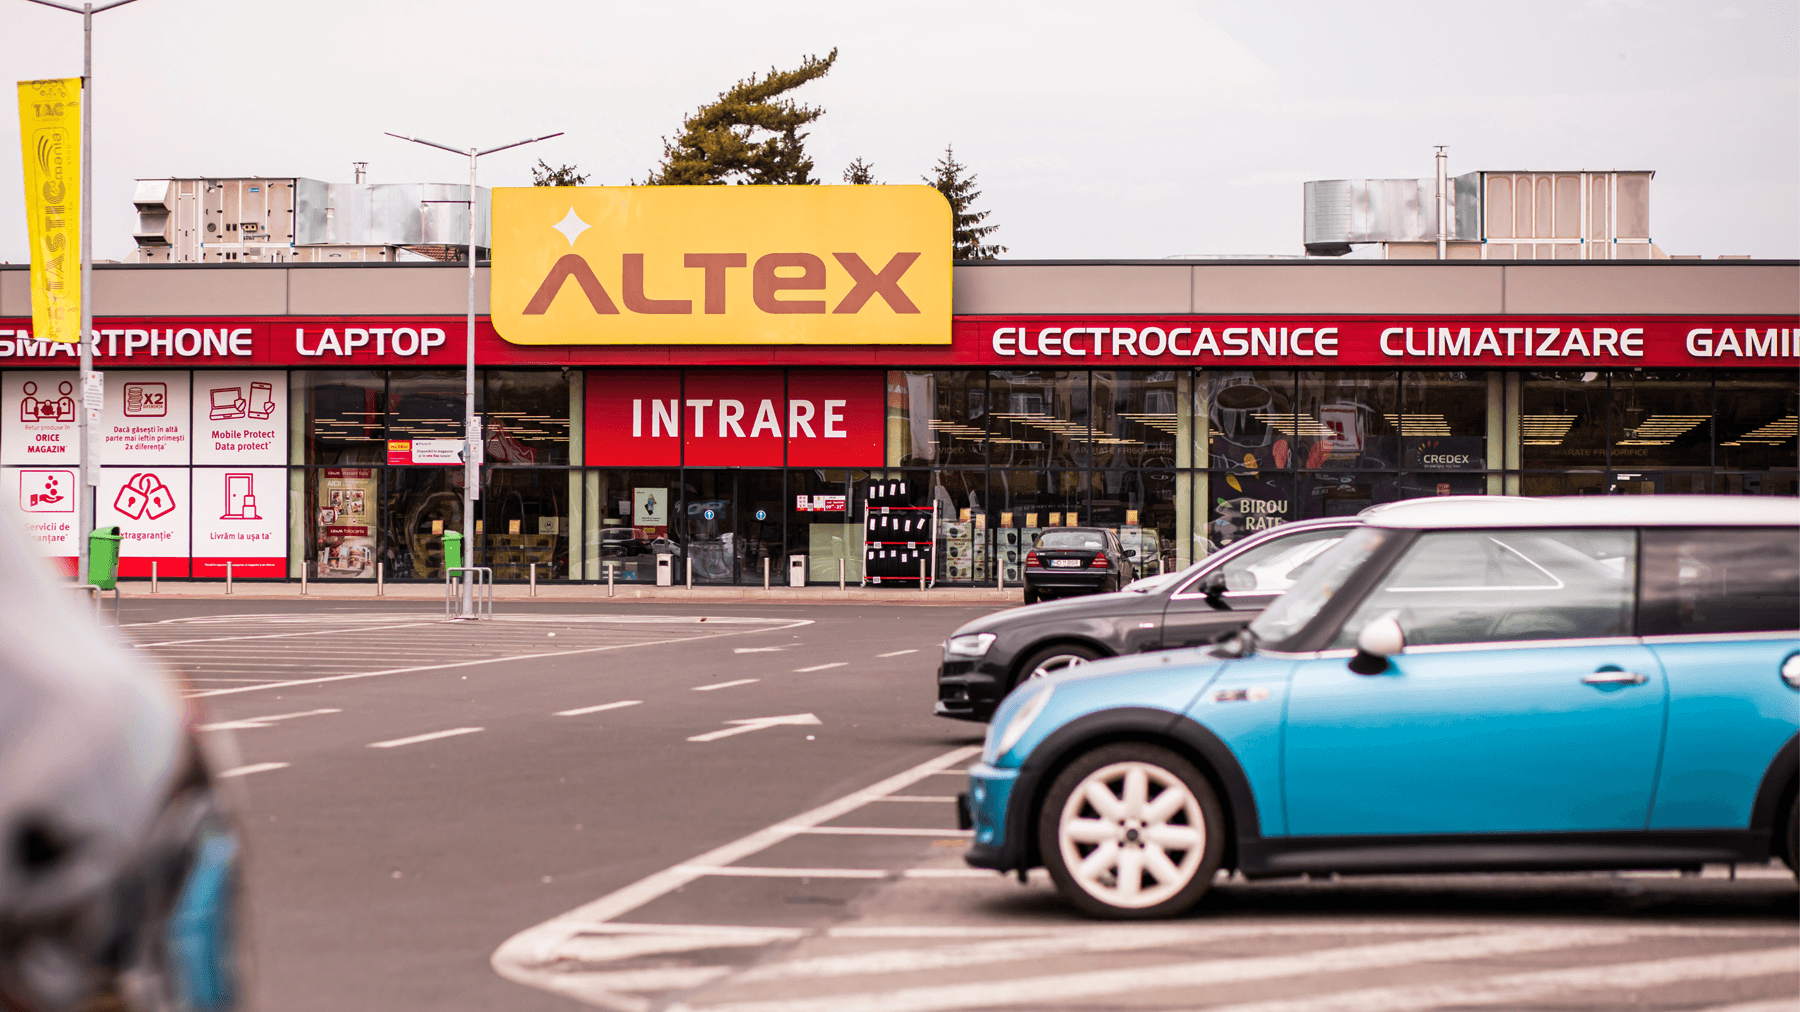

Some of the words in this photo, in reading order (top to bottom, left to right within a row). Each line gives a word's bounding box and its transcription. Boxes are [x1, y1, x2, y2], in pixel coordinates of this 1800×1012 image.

[295, 327, 446, 356] LAPTOP
[992, 326, 1339, 356] ELECTROCASNICE
[1379, 327, 1644, 357] CLIMATIZARE
[143, 393, 164, 405] X2
[632, 398, 848, 439] INTRARE
[40, 424, 64, 432] produse
[113, 425, 130, 433] Dacă
[156, 425, 164, 433] în
[165, 425, 178, 433] altă
[35, 433, 60, 442] ORICE
[105, 435, 123, 443] parte
[211, 429, 241, 439] Mobile
[243, 429, 275, 439] Protect
[215, 441, 235, 451] Data
[1423, 454, 1469, 464] CREDEX
[1240, 499, 1288, 514] BIROU
[24, 522, 57, 531] Servicii
[59, 522, 70, 531] de
[30, 533, 68, 544] nanțare
[120, 530, 174, 542] xtragaranție
[210, 531, 236, 540] Livrăm
[237, 531, 244, 540] la
[246, 532, 260, 542] ușa
